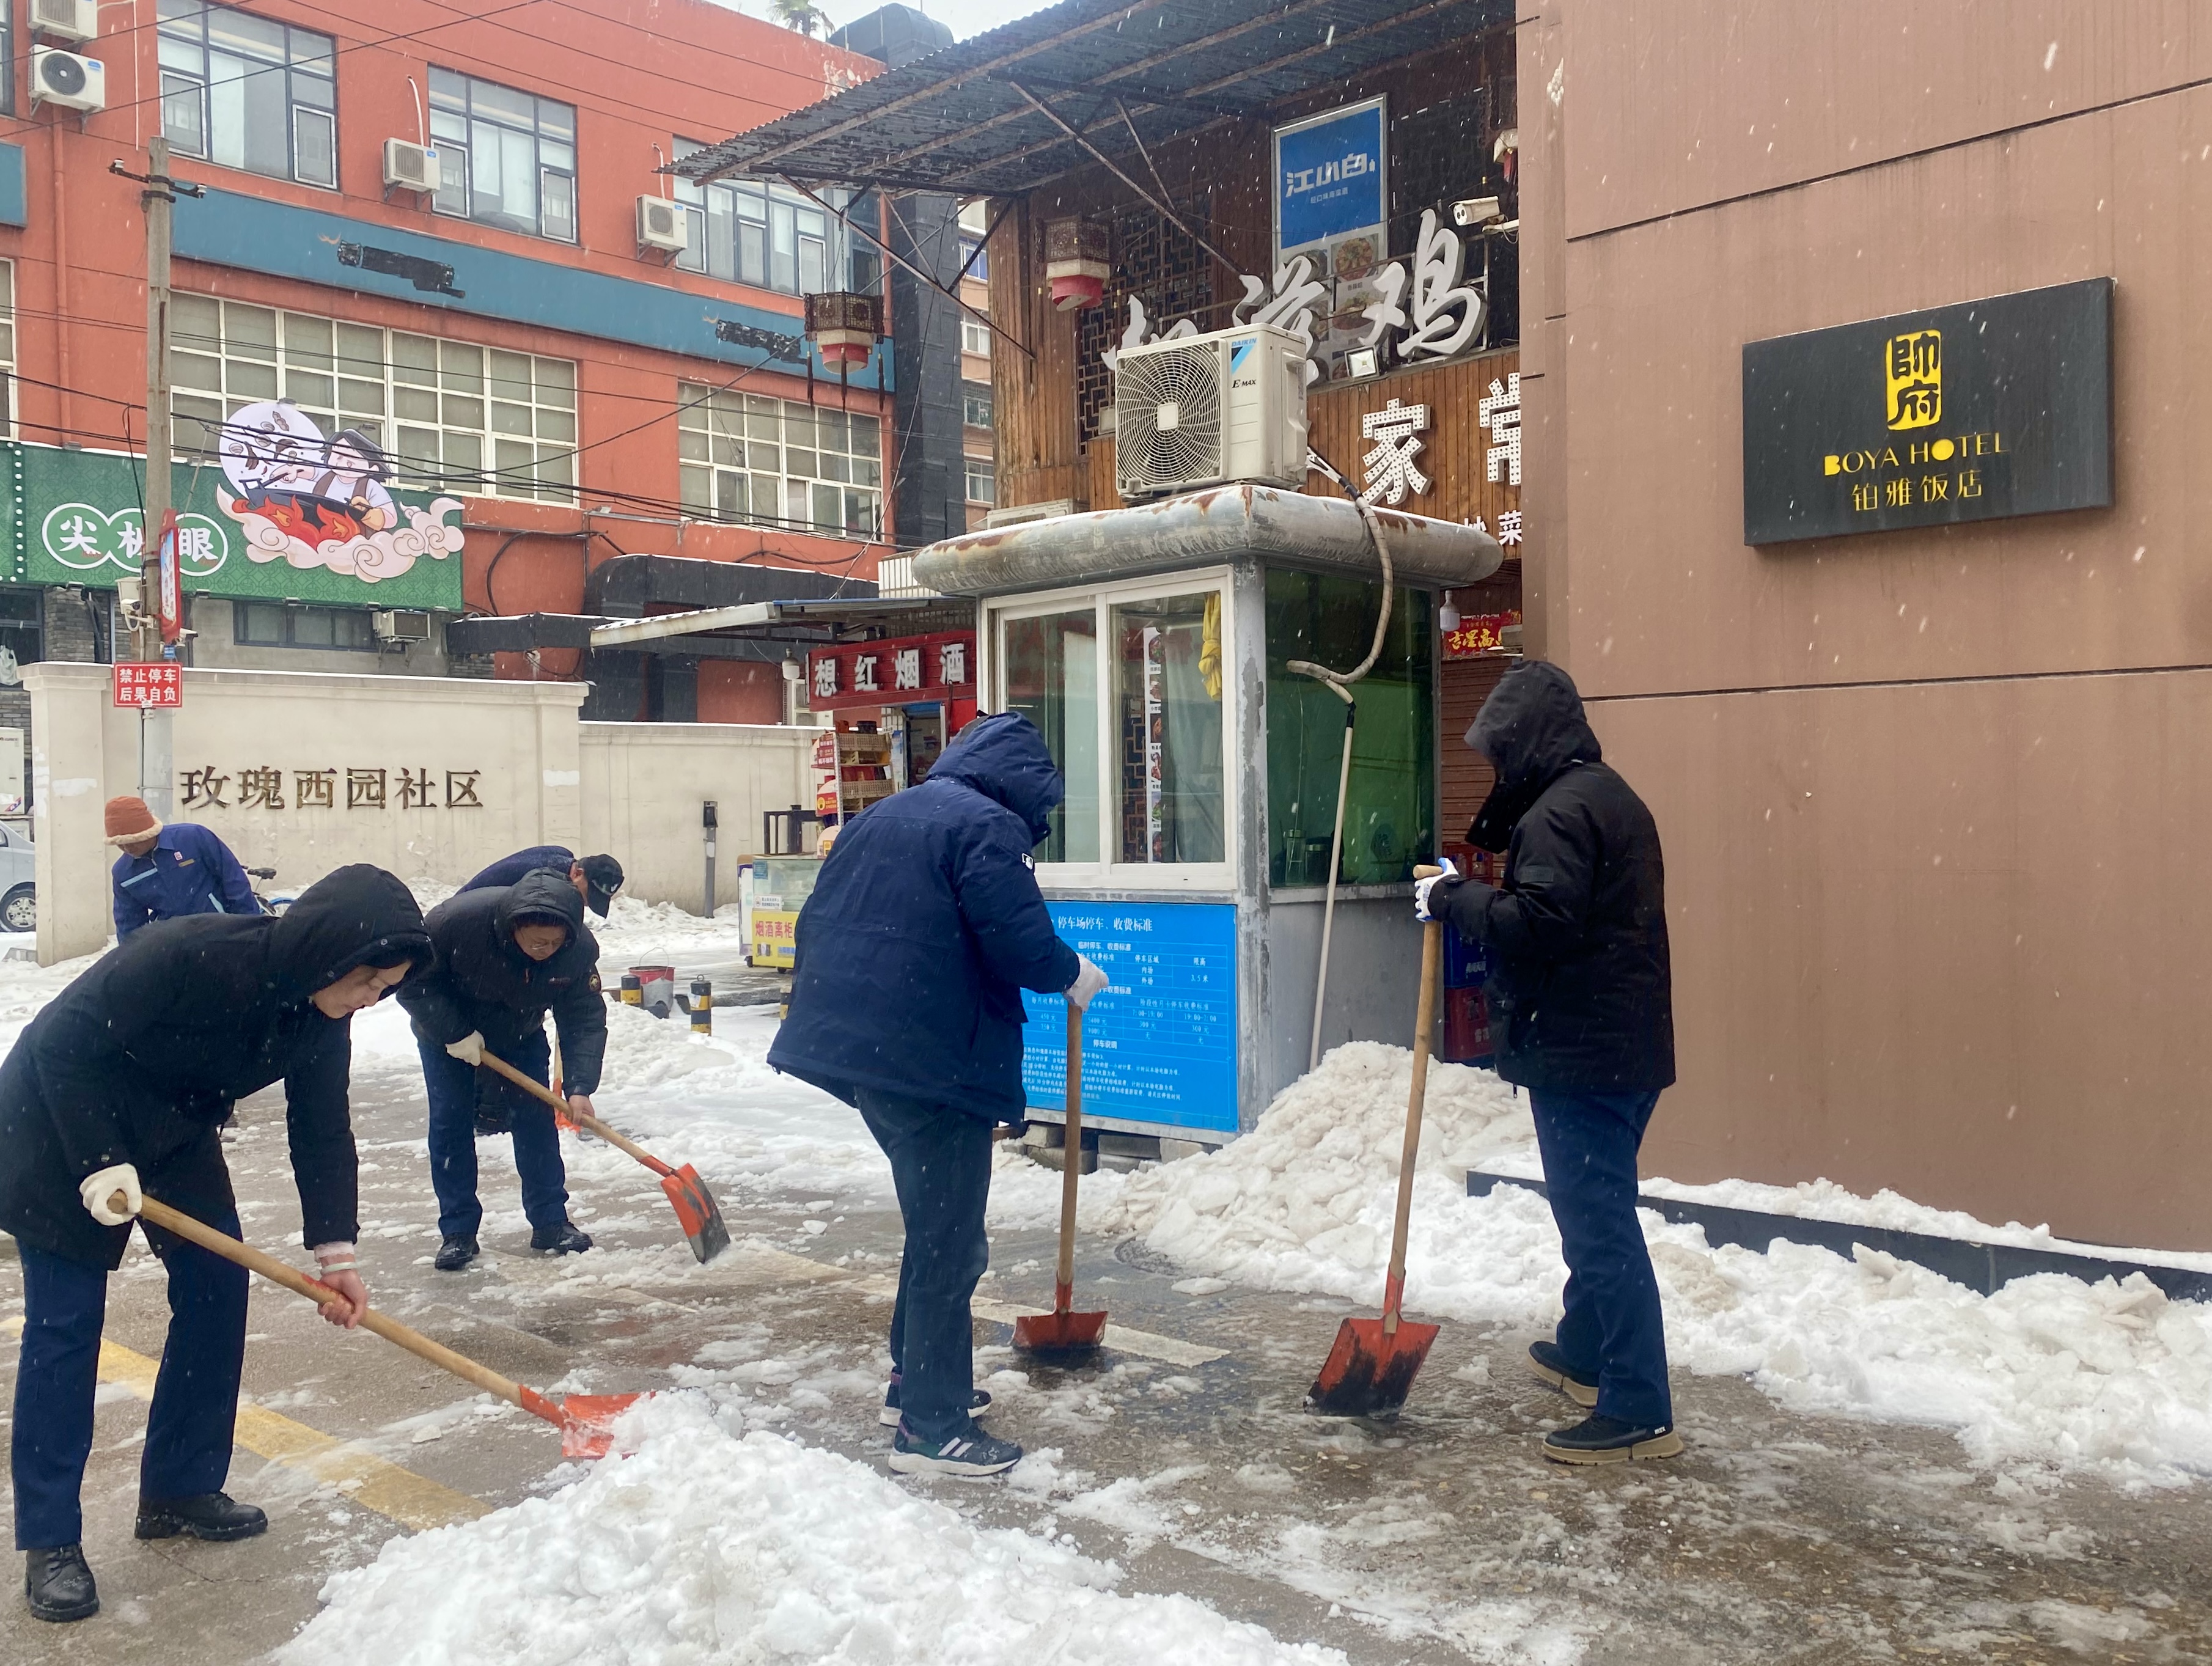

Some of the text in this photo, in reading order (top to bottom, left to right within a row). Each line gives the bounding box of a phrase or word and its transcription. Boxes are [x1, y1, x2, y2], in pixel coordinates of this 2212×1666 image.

[1285, 153, 1367, 197] 江小白
[1232, 338, 1257, 347] DAIKIN
[1824, 433, 2010, 476] BOYA HOTEL
[1852, 469, 1982, 511] 铂雅饭店
[1449, 628, 1502, 650] 吉星高
[119, 668, 177, 684] 禁止停车
[815, 644, 965, 698] 想红烟酒
[119, 686, 176, 702] 后果自负
[179, 765, 484, 810] 玫瑰西园社区
[755, 920, 793, 939] 烟酒离柜
[1135, 954, 1159, 964] 停车区域
[1193, 957, 1206, 966] 限高
[1141, 966, 1153, 974] 内场
[1141, 977, 1153, 985] 外场
[1093, 1039, 1117, 1049] 停车说明
